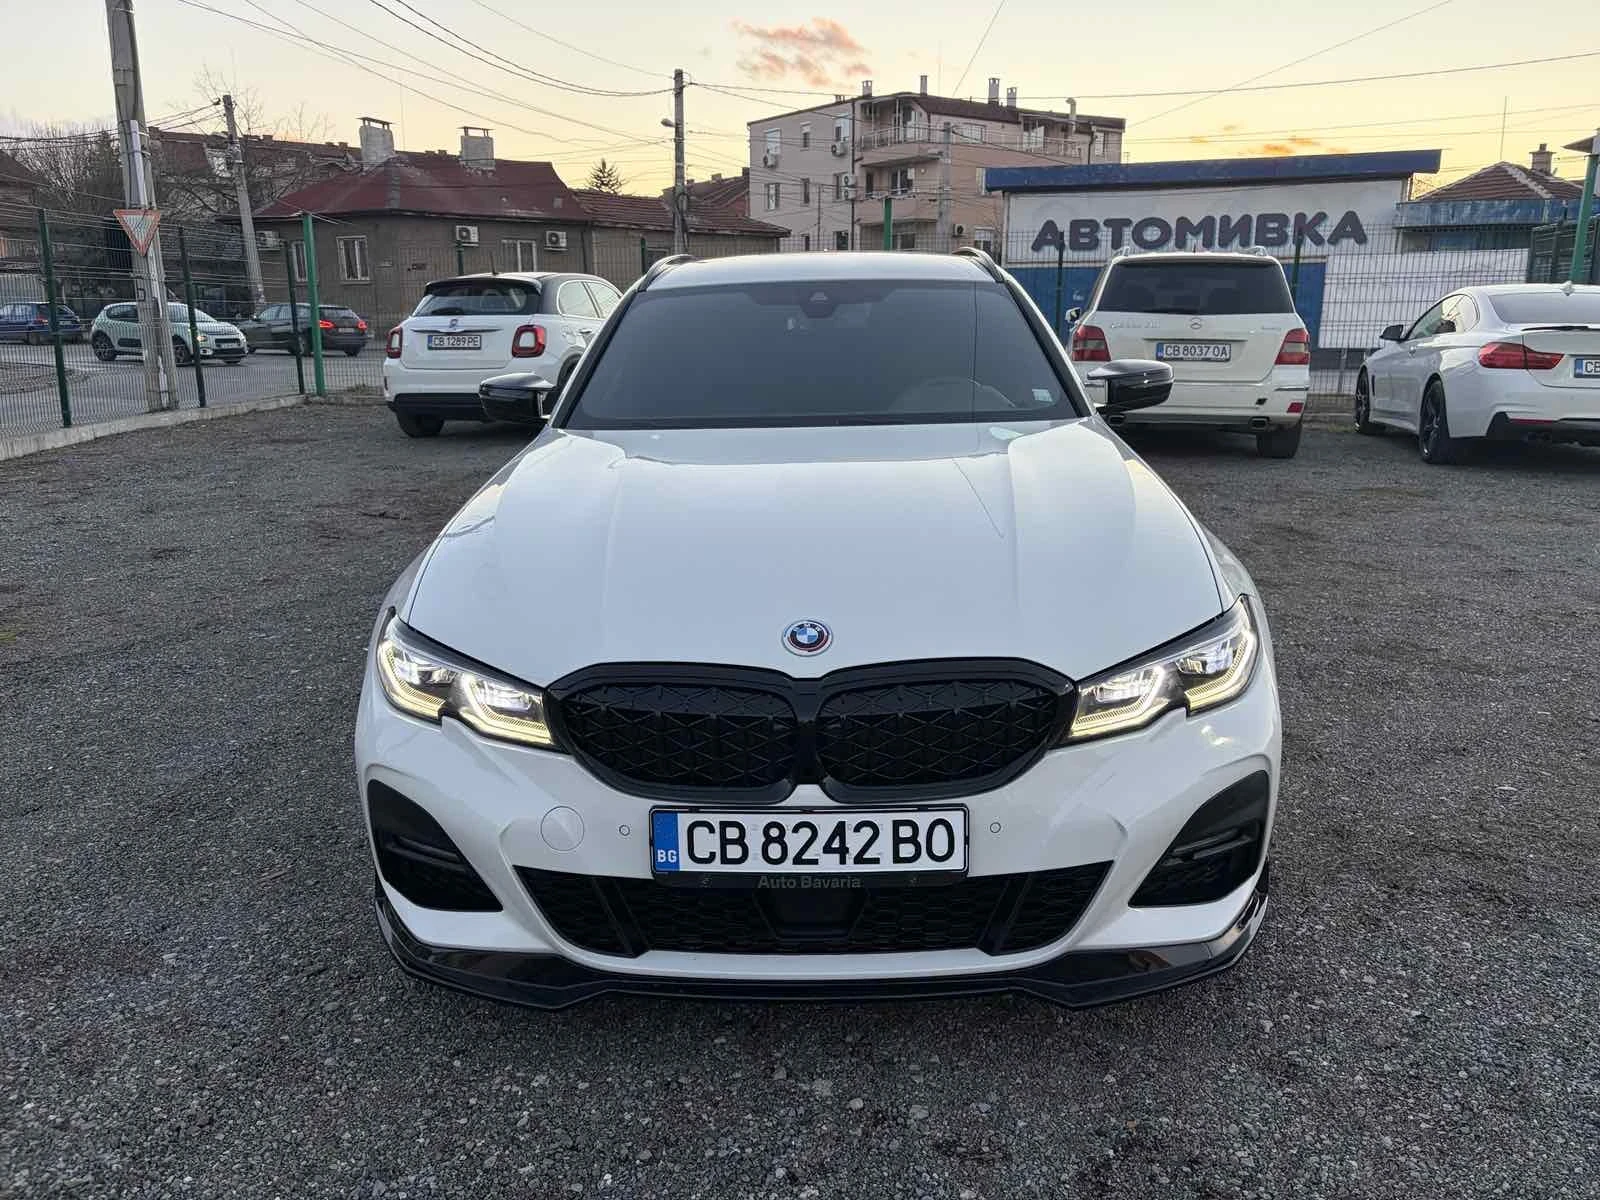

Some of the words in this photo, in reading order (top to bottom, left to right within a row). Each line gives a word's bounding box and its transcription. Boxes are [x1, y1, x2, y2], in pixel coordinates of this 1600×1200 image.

[1031, 210, 1369, 252] АВТОМИВКА
[1165, 345, 1180, 356] CB
[1182, 345, 1210, 357] 8037
[687, 820, 748, 865] CB
[761, 820, 880, 865] 8242
[892, 818, 955, 864] BO
[656, 849, 677, 863] BG
[757, 875, 798, 888] Auto
[801, 875, 862, 888] Bavaria
